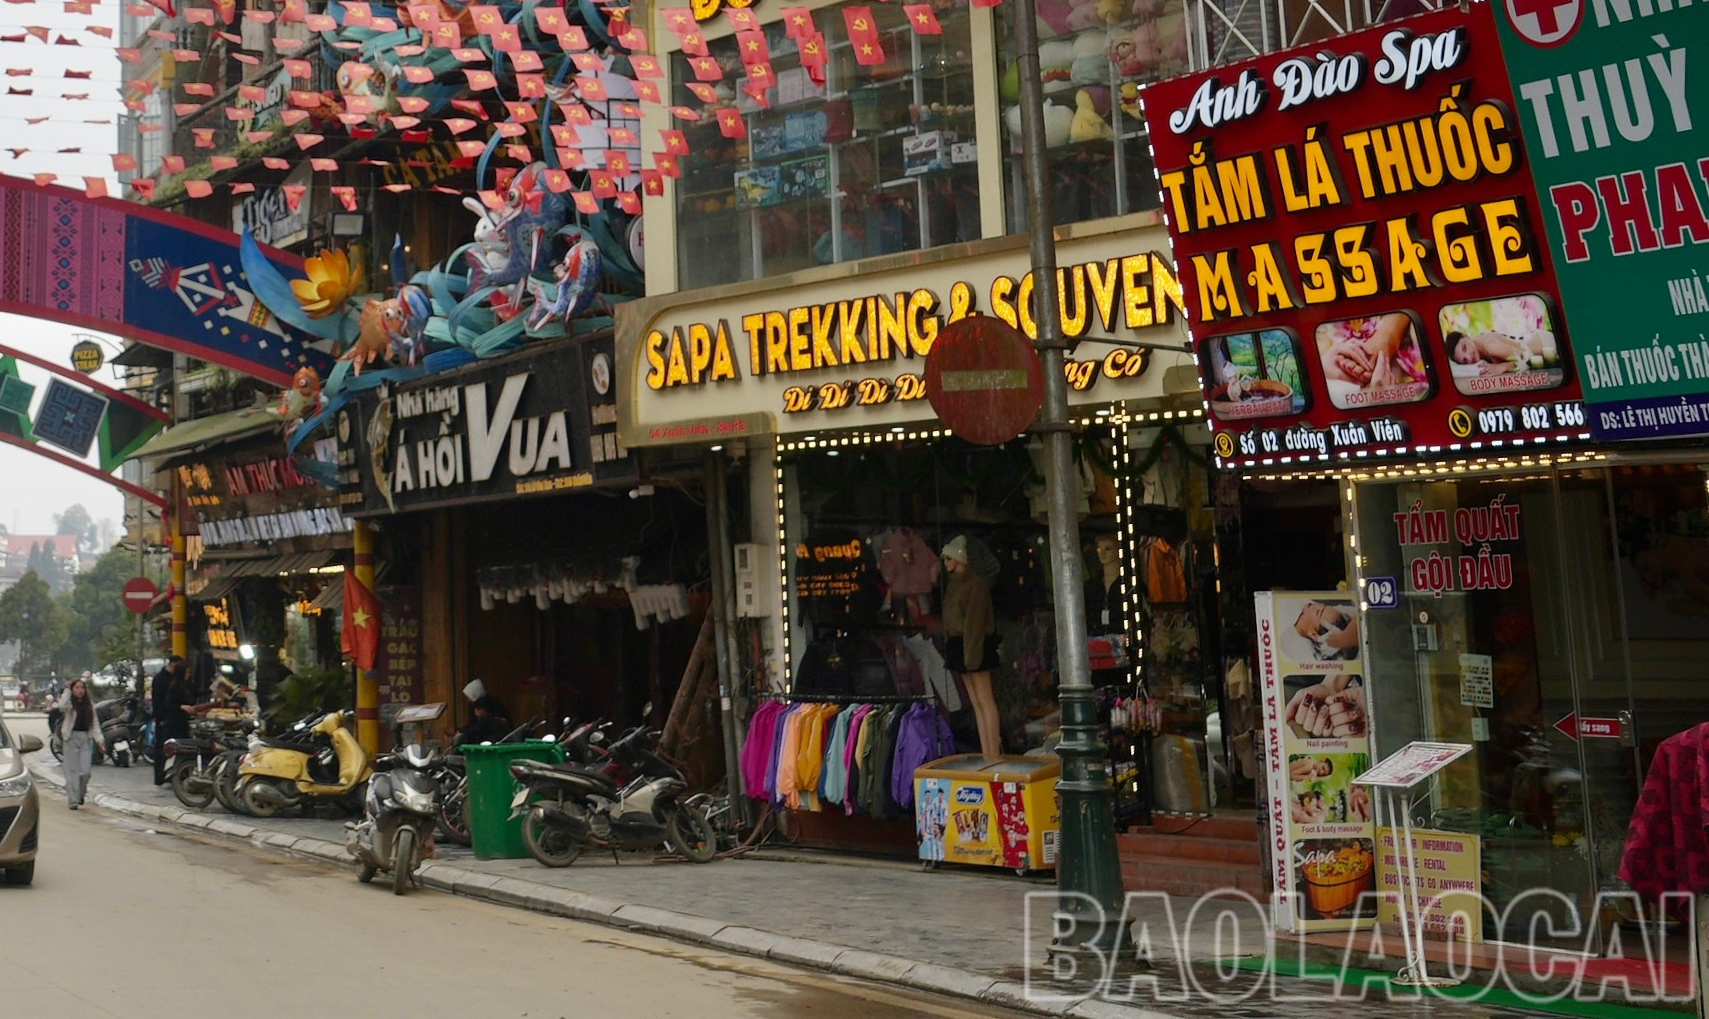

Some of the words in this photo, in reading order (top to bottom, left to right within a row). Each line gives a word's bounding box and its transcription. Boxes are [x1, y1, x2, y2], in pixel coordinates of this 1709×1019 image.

[1169, 80, 1263, 135] Anh
[1273, 51, 1361, 112] Đào
[1374, 25, 1462, 93] Spa
[1161, 140, 1267, 235] TẮM
[1274, 127, 1342, 214] LÁ
[1343, 85, 1516, 201] THUỐC
[1192, 200, 1536, 323] MASSAGE
[645, 319, 739, 391] SAPA
[743, 287, 942, 377] TREKKING
[1584, 345, 1624, 389] BÁN
[1620, 333, 1680, 385] THUỐC
[1344, 391, 1367, 406] FOOT
[1367, 385, 1416, 404] MASSAGE
[1469, 377, 1497, 392] BODY
[1498, 371, 1549, 389] MASSAGE
[465, 372, 572, 482] VUA
[1479, 410, 1514, 434] 0979
[1521, 407, 1550, 431] 802
[1555, 402, 1585, 427] 566
[1600, 411, 1621, 430] DS:
[1621, 405, 1636, 428] LÊ
[1636, 407, 1659, 431] THỊ
[1658, 396, 1700, 426] HUYỀN
[1239, 426, 1257, 455] Số
[1262, 432, 1279, 453] 02
[1284, 422, 1326, 454] đường
[1331, 422, 1367, 446] Xuân
[1370, 418, 1403, 444] Viên
[1394, 499, 1449, 546] TẨM
[1455, 493, 1520, 547] QUẤT
[1411, 550, 1454, 598] GỘI
[1459, 543, 1513, 591] ĐẦU
[1367, 581, 1394, 606] 02
[1316, 663, 1344, 671] washing
[1321, 740, 1348, 749] painting
[1301, 825, 1315, 833] Foot
[1322, 825, 1336, 834] body
[1337, 826, 1363, 834] massage
[1422, 839, 1464, 853] INFORMATION
[1293, 842, 1337, 878] Sapa
[1423, 858, 1447, 871] RENTAL
[1384, 873, 1397, 885] BUS
[1427, 878, 1437, 890] GO
[1439, 879, 1475, 891] ANYWHERE
